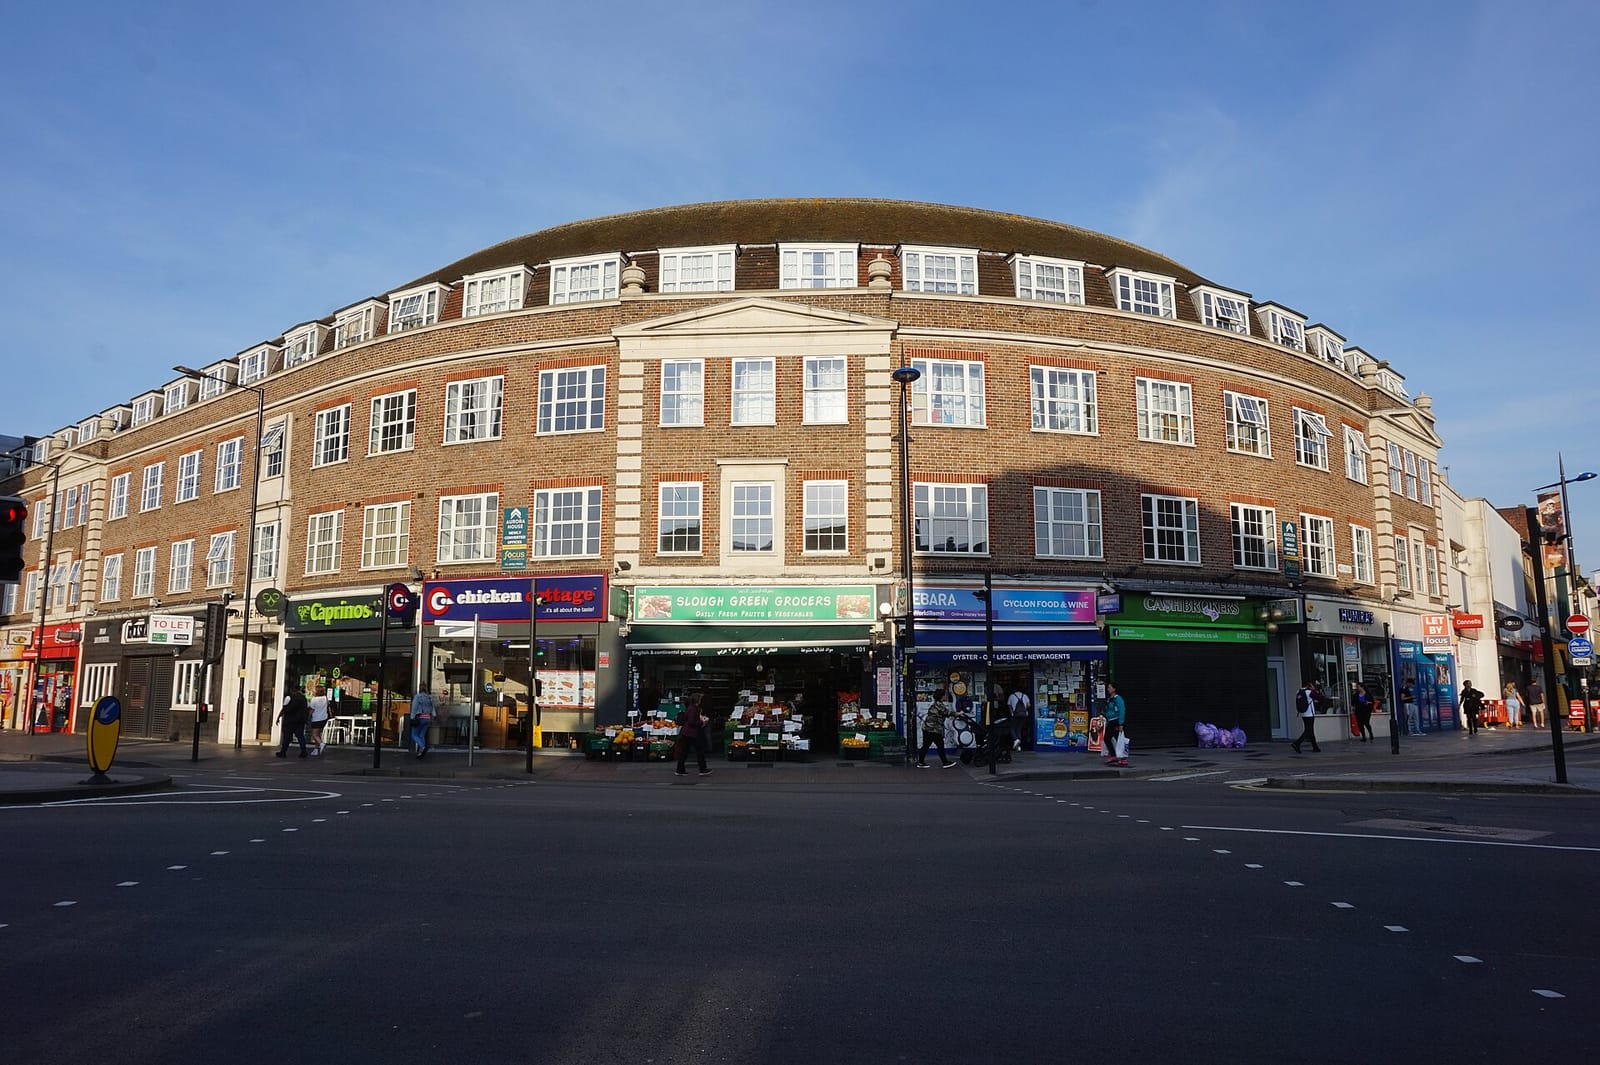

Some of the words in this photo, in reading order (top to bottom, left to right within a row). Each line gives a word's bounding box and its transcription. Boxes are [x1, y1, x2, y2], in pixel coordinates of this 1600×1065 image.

[503, 550, 526, 561] focus
[456, 589, 523, 605] chicken
[676, 596, 724, 607] SLOUGH
[729, 595, 769, 607] GREEN
[775, 596, 832, 607] GROCERS
[913, 592, 957, 606] EBARA
[1003, 599, 1037, 608] CYCLON
[1036, 600, 1060, 609] FOOD
[1060, 601, 1067, 609] &
[1067, 601, 1089, 609] WINE
[311, 600, 373, 625] Caprinos
[153, 620, 168, 628] TO
[170, 621, 191, 629] LET
[1425, 616, 1444, 625] LET
[1429, 625, 1443, 635] BY
